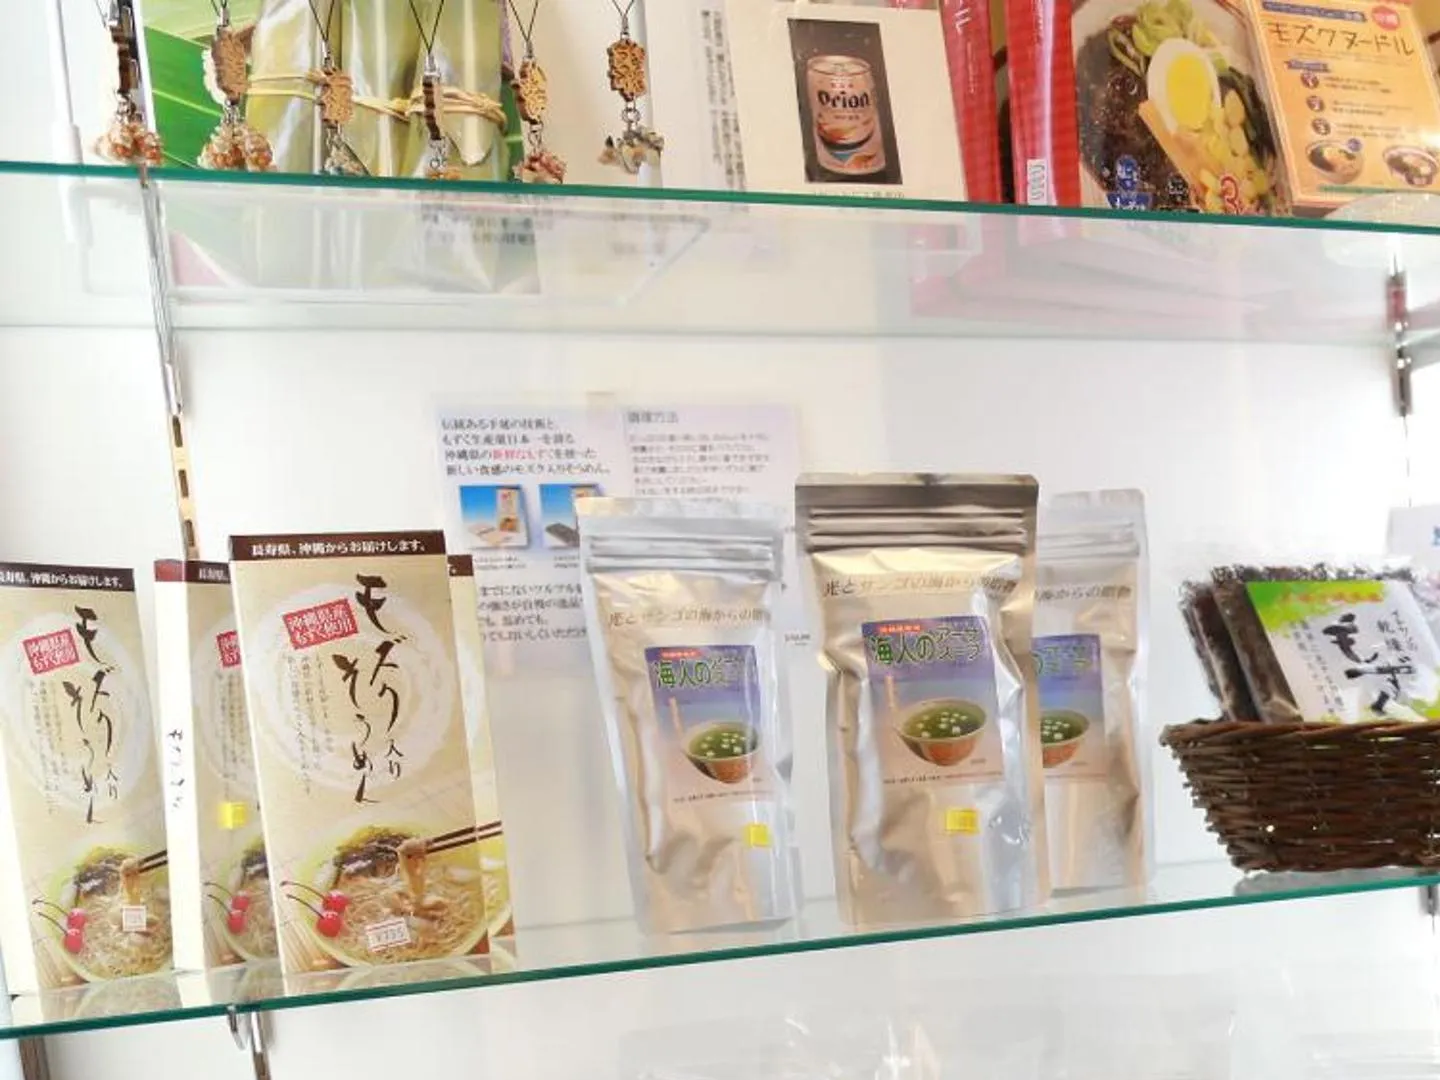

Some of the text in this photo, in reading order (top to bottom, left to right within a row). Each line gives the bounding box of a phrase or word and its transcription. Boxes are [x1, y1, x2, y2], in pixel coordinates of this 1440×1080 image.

[1269, 20, 1415, 57] モズクヌードル
[817, 90, 871, 109] Orion
[252, 540, 426, 556] 長寿県、沖縄からお届けします。
